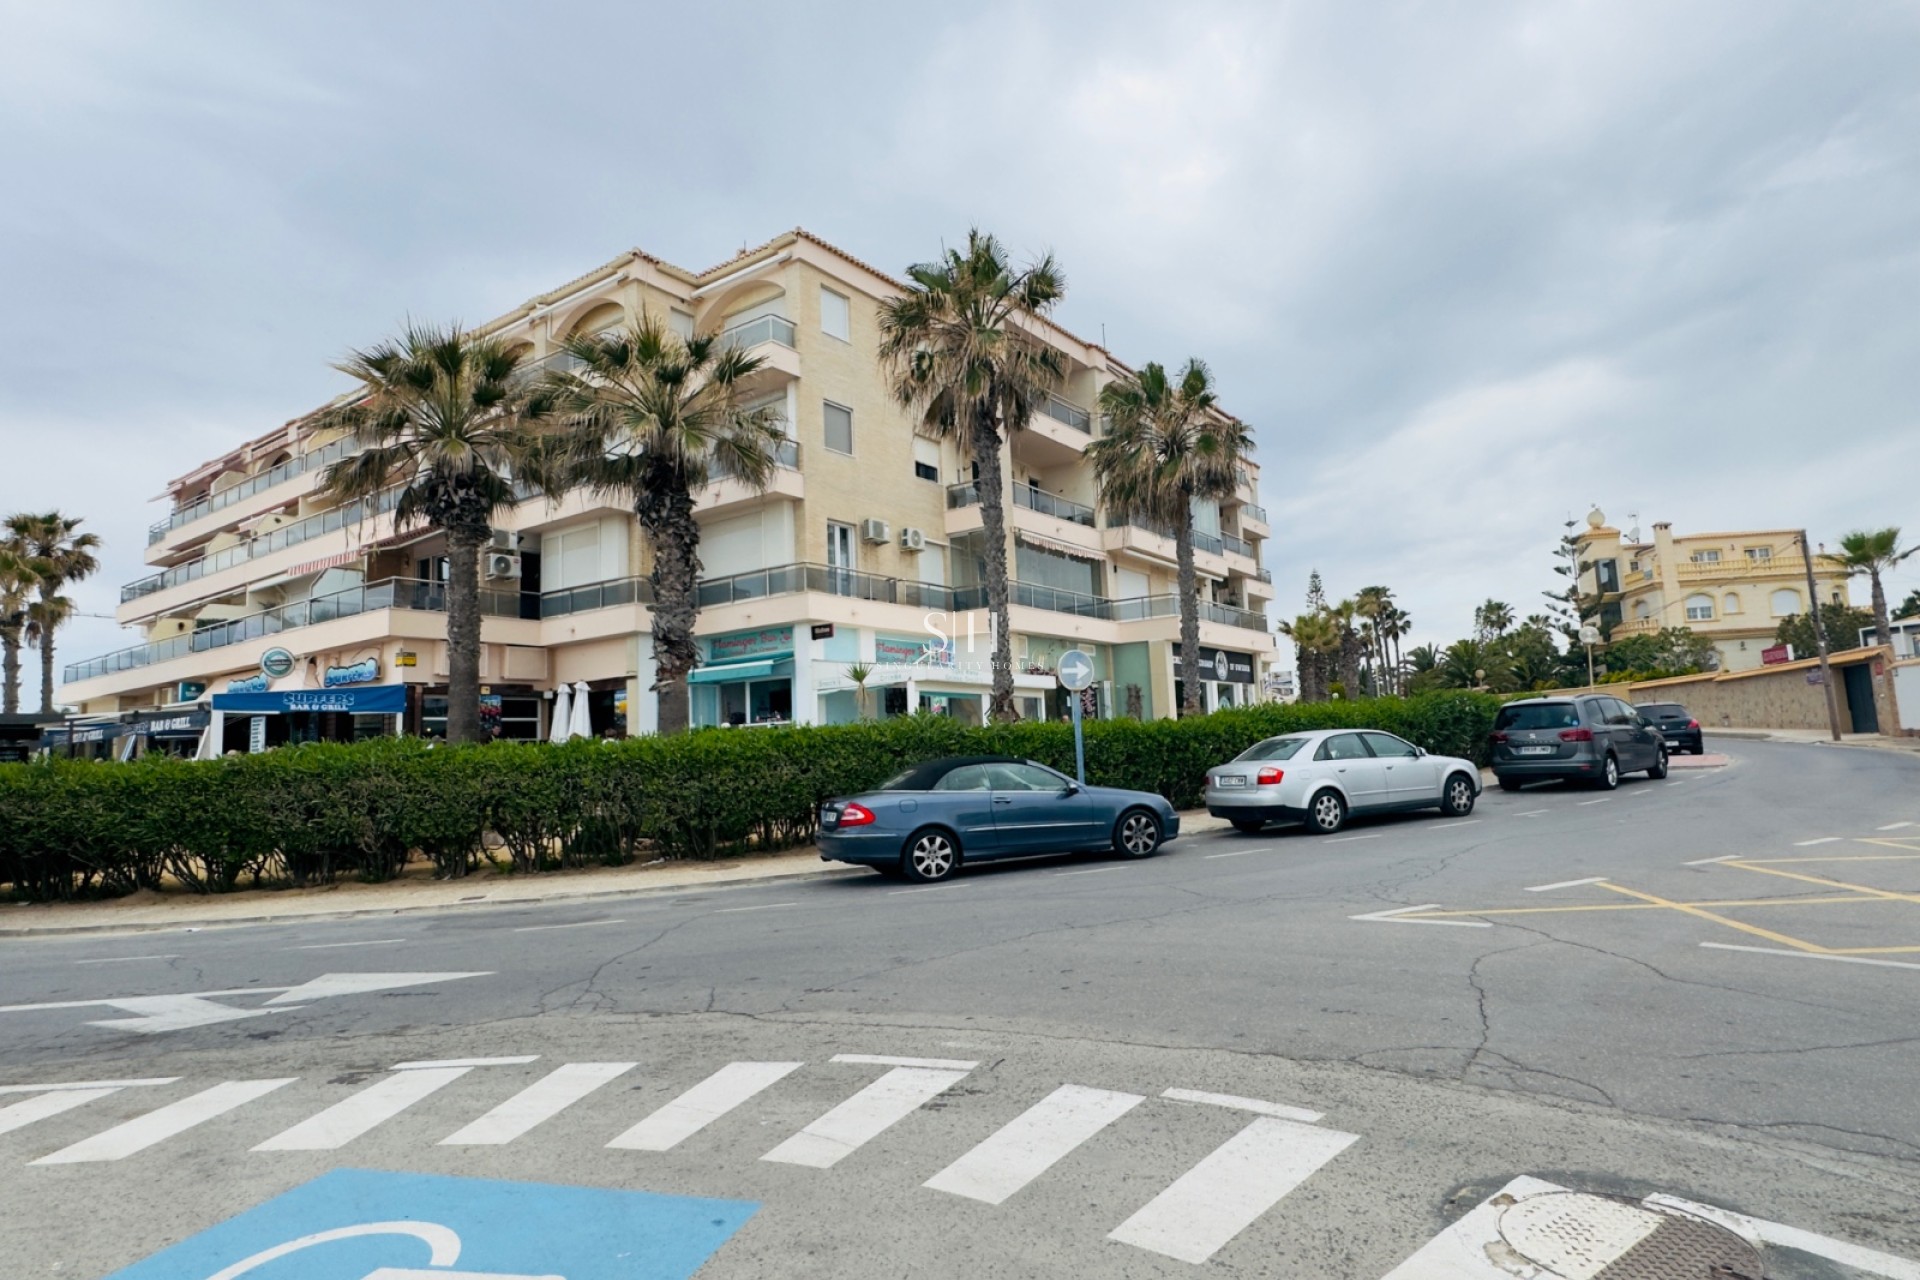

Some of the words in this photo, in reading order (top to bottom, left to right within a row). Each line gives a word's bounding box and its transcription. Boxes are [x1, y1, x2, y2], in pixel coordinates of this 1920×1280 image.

[282, 692, 355, 705] SURFERS
[321, 703, 349, 711] GRILL
[150, 720, 164, 732] BAR
[171, 716, 191, 729] GRILL
